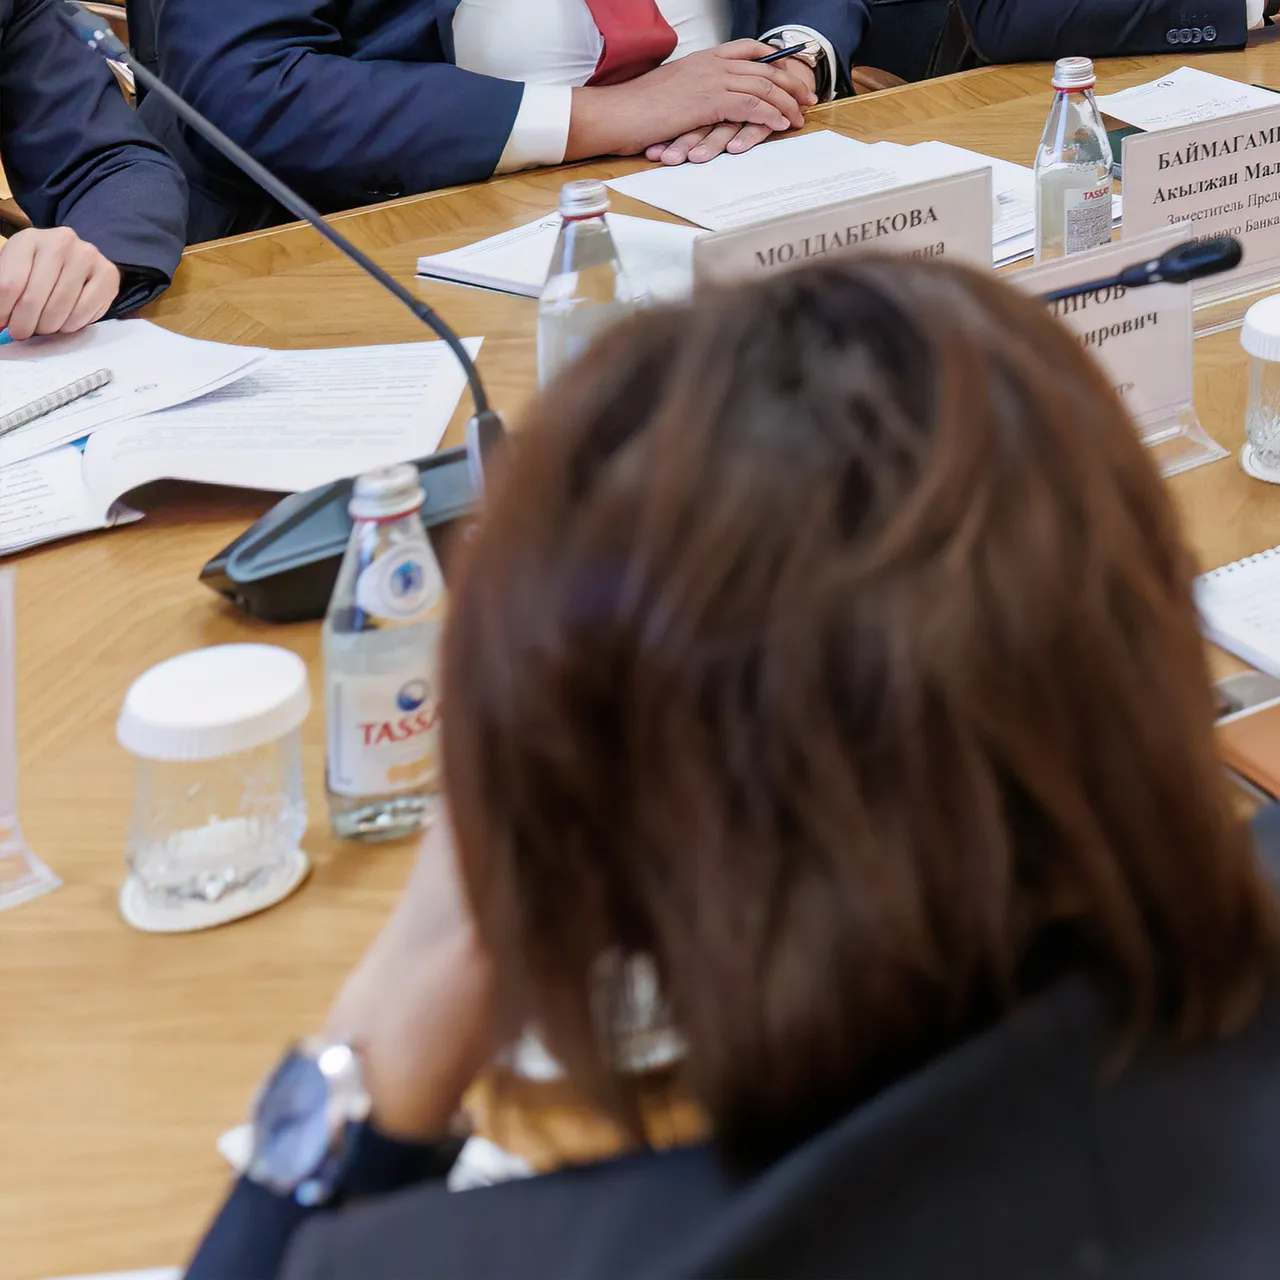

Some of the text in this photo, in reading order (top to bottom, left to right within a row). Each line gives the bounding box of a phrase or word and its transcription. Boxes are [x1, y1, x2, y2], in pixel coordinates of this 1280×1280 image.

[1152, 172, 1238, 205] Акылжан
[1167, 200, 1244, 226] Заместитель
[1245, 215, 1280, 233] Банка
[755, 206, 939, 268] МОЛДАБЕКОВА
[1078, 312, 1158, 348] ирович
